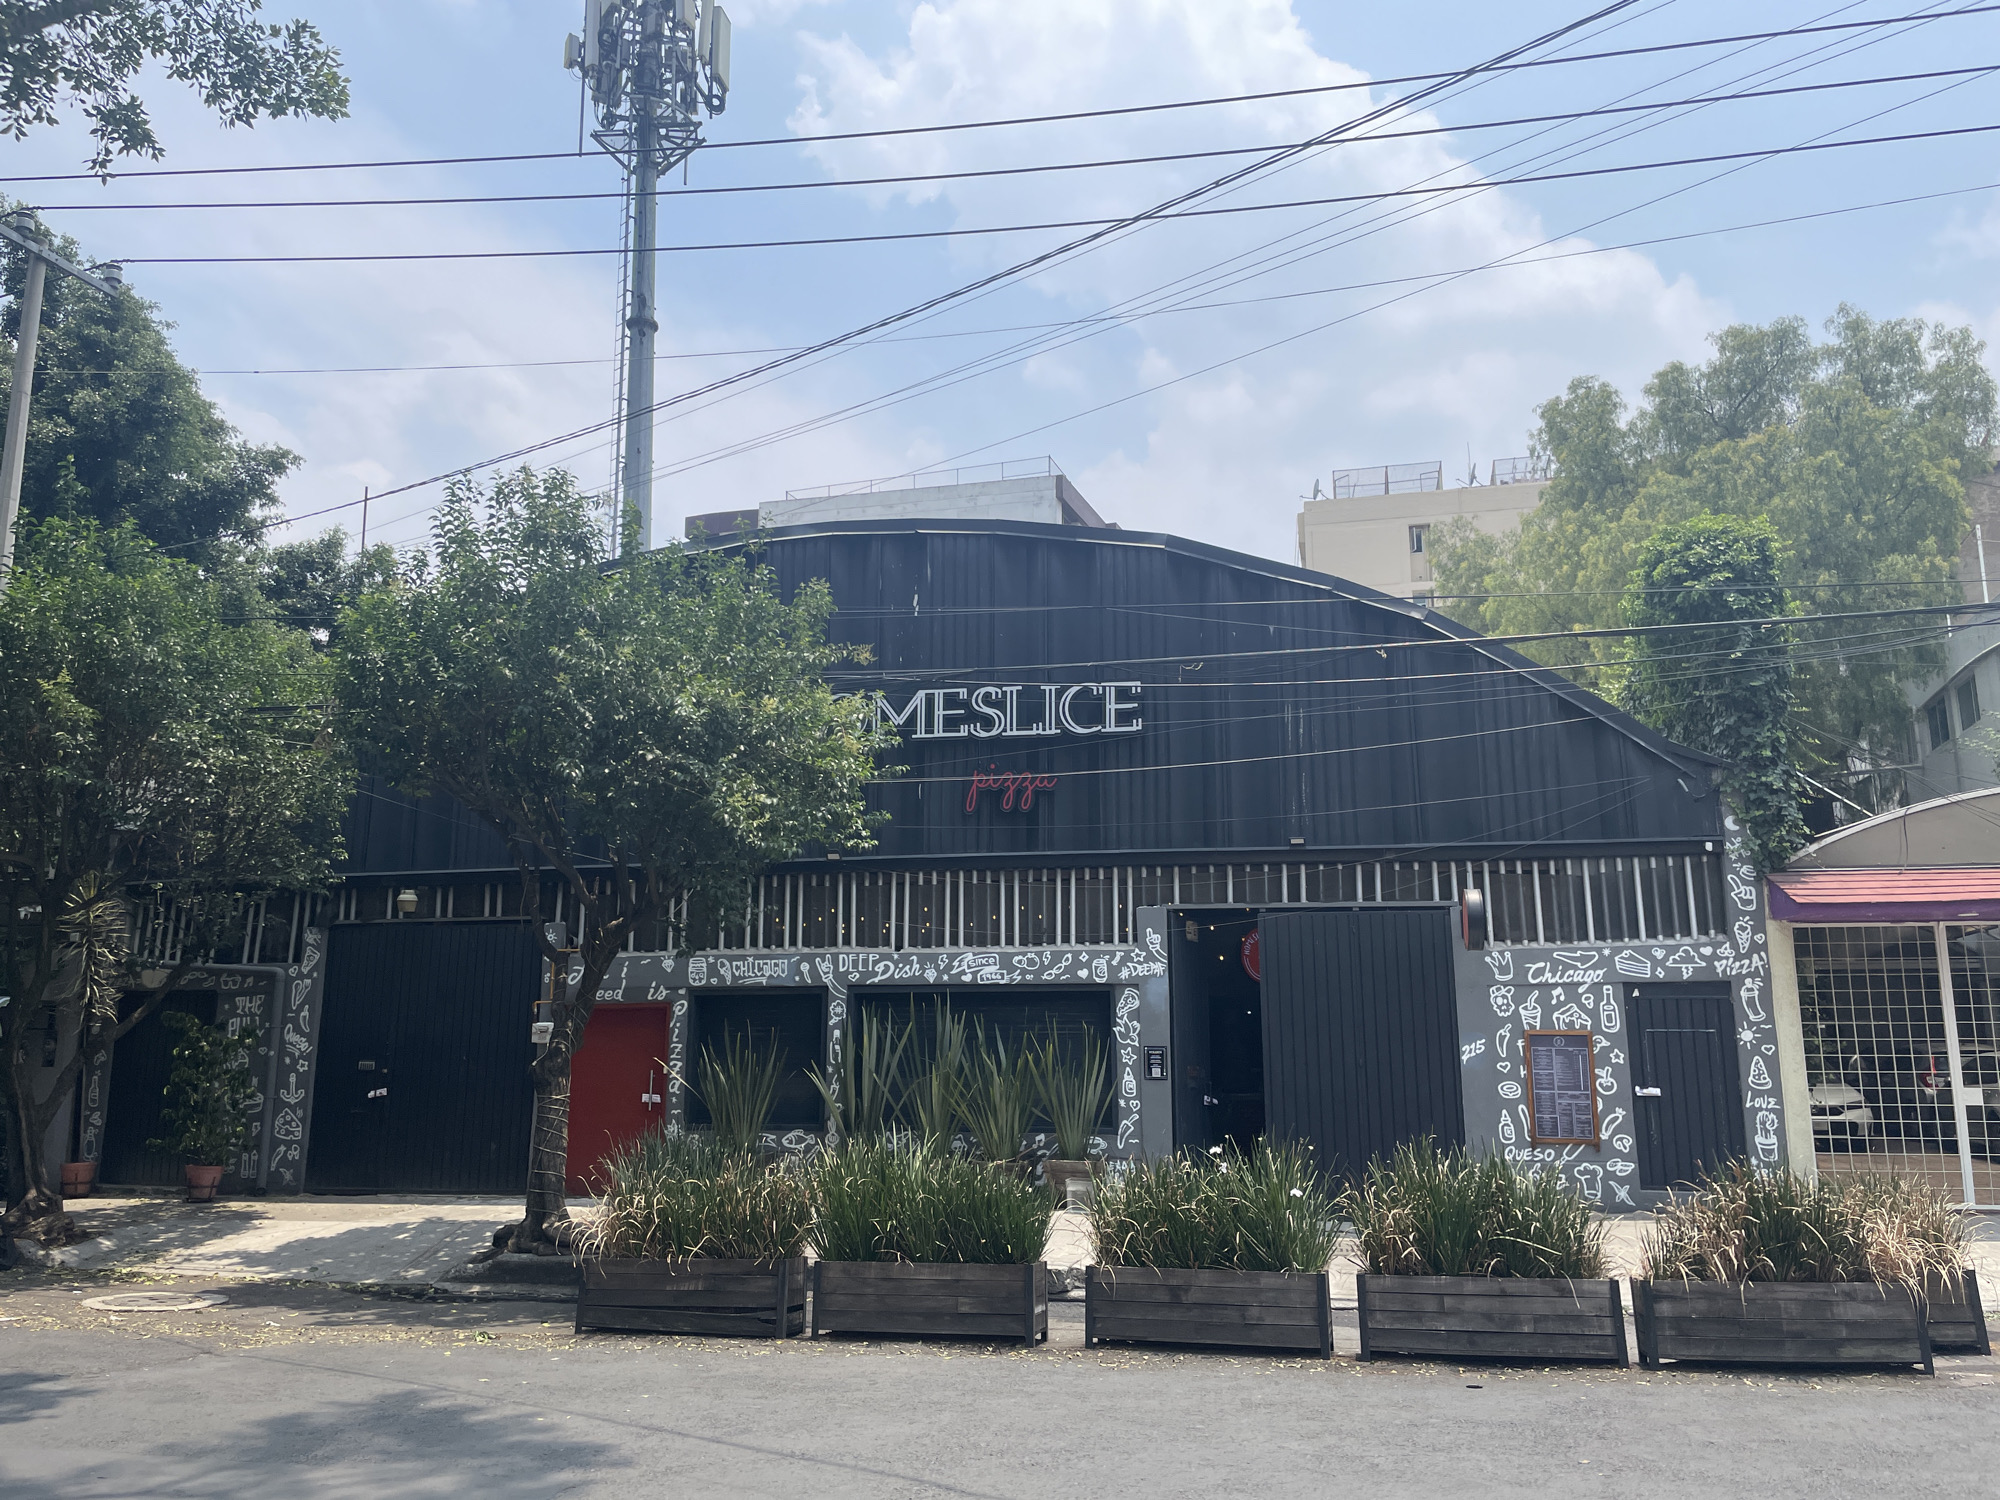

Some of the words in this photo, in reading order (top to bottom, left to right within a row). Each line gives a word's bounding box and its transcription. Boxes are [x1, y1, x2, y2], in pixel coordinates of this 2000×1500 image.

[966, 763, 1057, 811] pizza
[838, 953, 880, 972] DEEP
[866, 955, 922, 984] Dish
[595, 979, 625, 1001] eed
[647, 980, 671, 1000] is
[234, 994, 265, 1015] THE
[1504, 1147, 1555, 1161] QUESO
